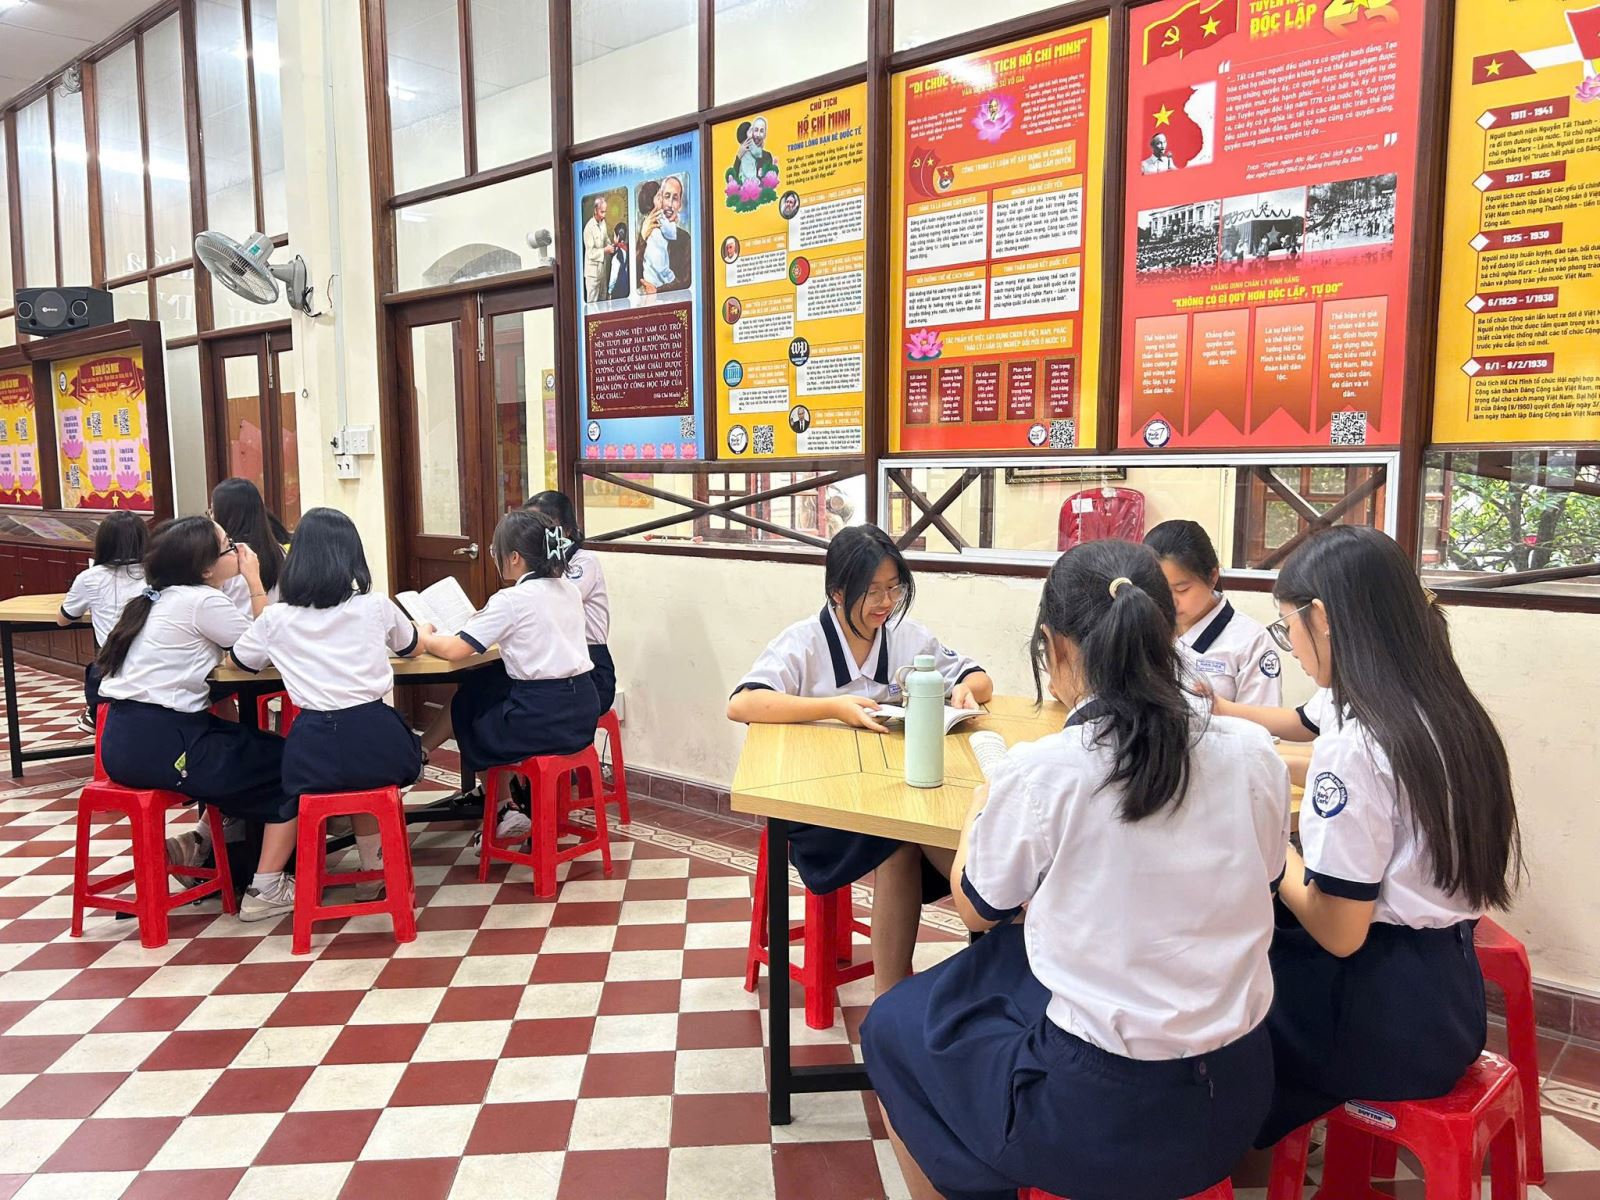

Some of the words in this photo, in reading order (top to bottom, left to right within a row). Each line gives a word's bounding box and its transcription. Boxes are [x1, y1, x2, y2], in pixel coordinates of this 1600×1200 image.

[1285, 2, 1317, 29] LẬP
[994, 56, 1016, 74] TỊCH
[1019, 47, 1033, 66] HỒ
[1035, 44, 1052, 63] CHÍ
[810, 98, 822, 111] CHỦ
[824, 96, 837, 110] TỊCH
[797, 114, 809, 132] HỒ
[811, 112, 825, 129] CHÍ
[828, 108, 850, 128] MINH
[661, 146, 673, 158] CHÍ
[674, 142, 692, 157] MINH
[788, 142, 803, 152] TRONG
[579, 166, 600, 181] KHÔNG
[1505, 173, 1523, 183] 1921
[1531, 169, 1551, 179] 1925
[1530, 231, 1549, 240] 1930
[1205, 295, 1217, 305] CÓ
[1218, 293, 1227, 304] GÌ
[1228, 292, 1246, 304] QUÝ
[1247, 290, 1266, 301] HƠN
[1287, 285, 1308, 297] LẬP,
[1312, 284, 1324, 295] TỰ
[1488, 296, 1518, 307] 6/1929
[1525, 293, 1554, 304] 1/1930
[1485, 362, 1500, 370] 6/1
[1507, 360, 1548, 369] 8/2/1930
